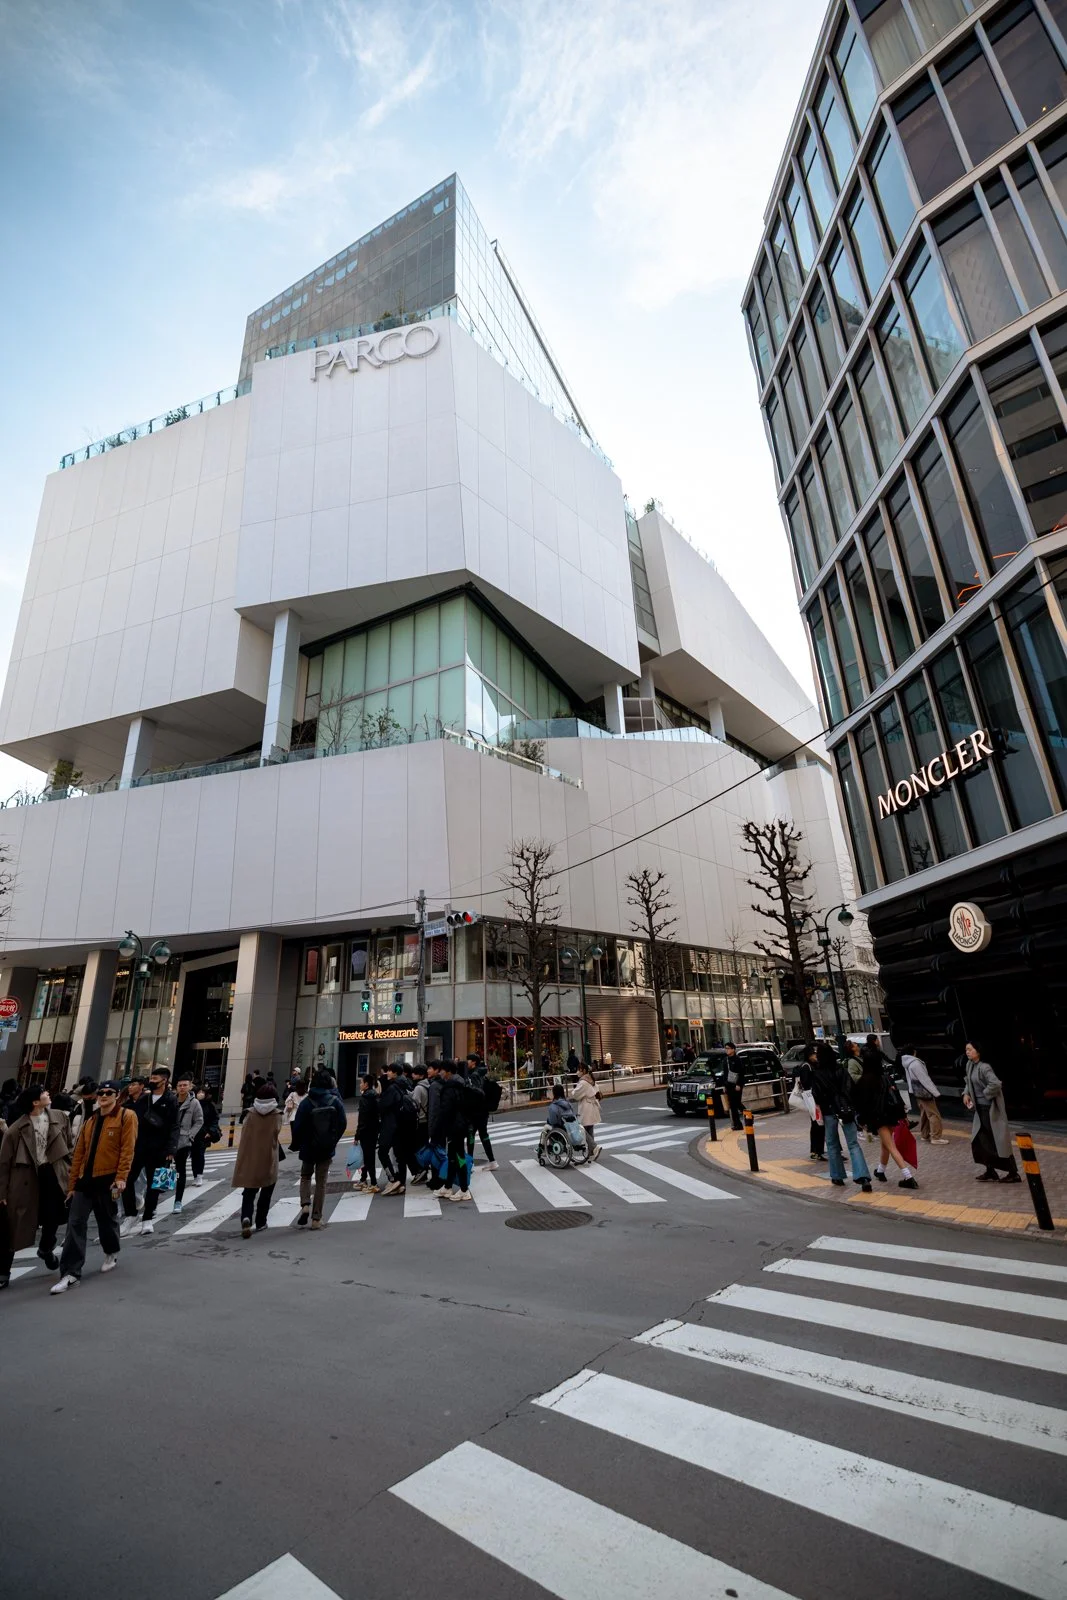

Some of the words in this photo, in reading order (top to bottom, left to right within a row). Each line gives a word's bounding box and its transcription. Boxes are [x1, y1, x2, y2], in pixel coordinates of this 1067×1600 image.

[310, 325, 440, 382] PARCO
[877, 729, 995, 820] MONCLER
[954, 928, 980, 946] MONCLER
[338, 1031, 367, 1041] Theater
[366, 1030, 374, 1040] &
[374, 1027, 419, 1039] Restaurants
